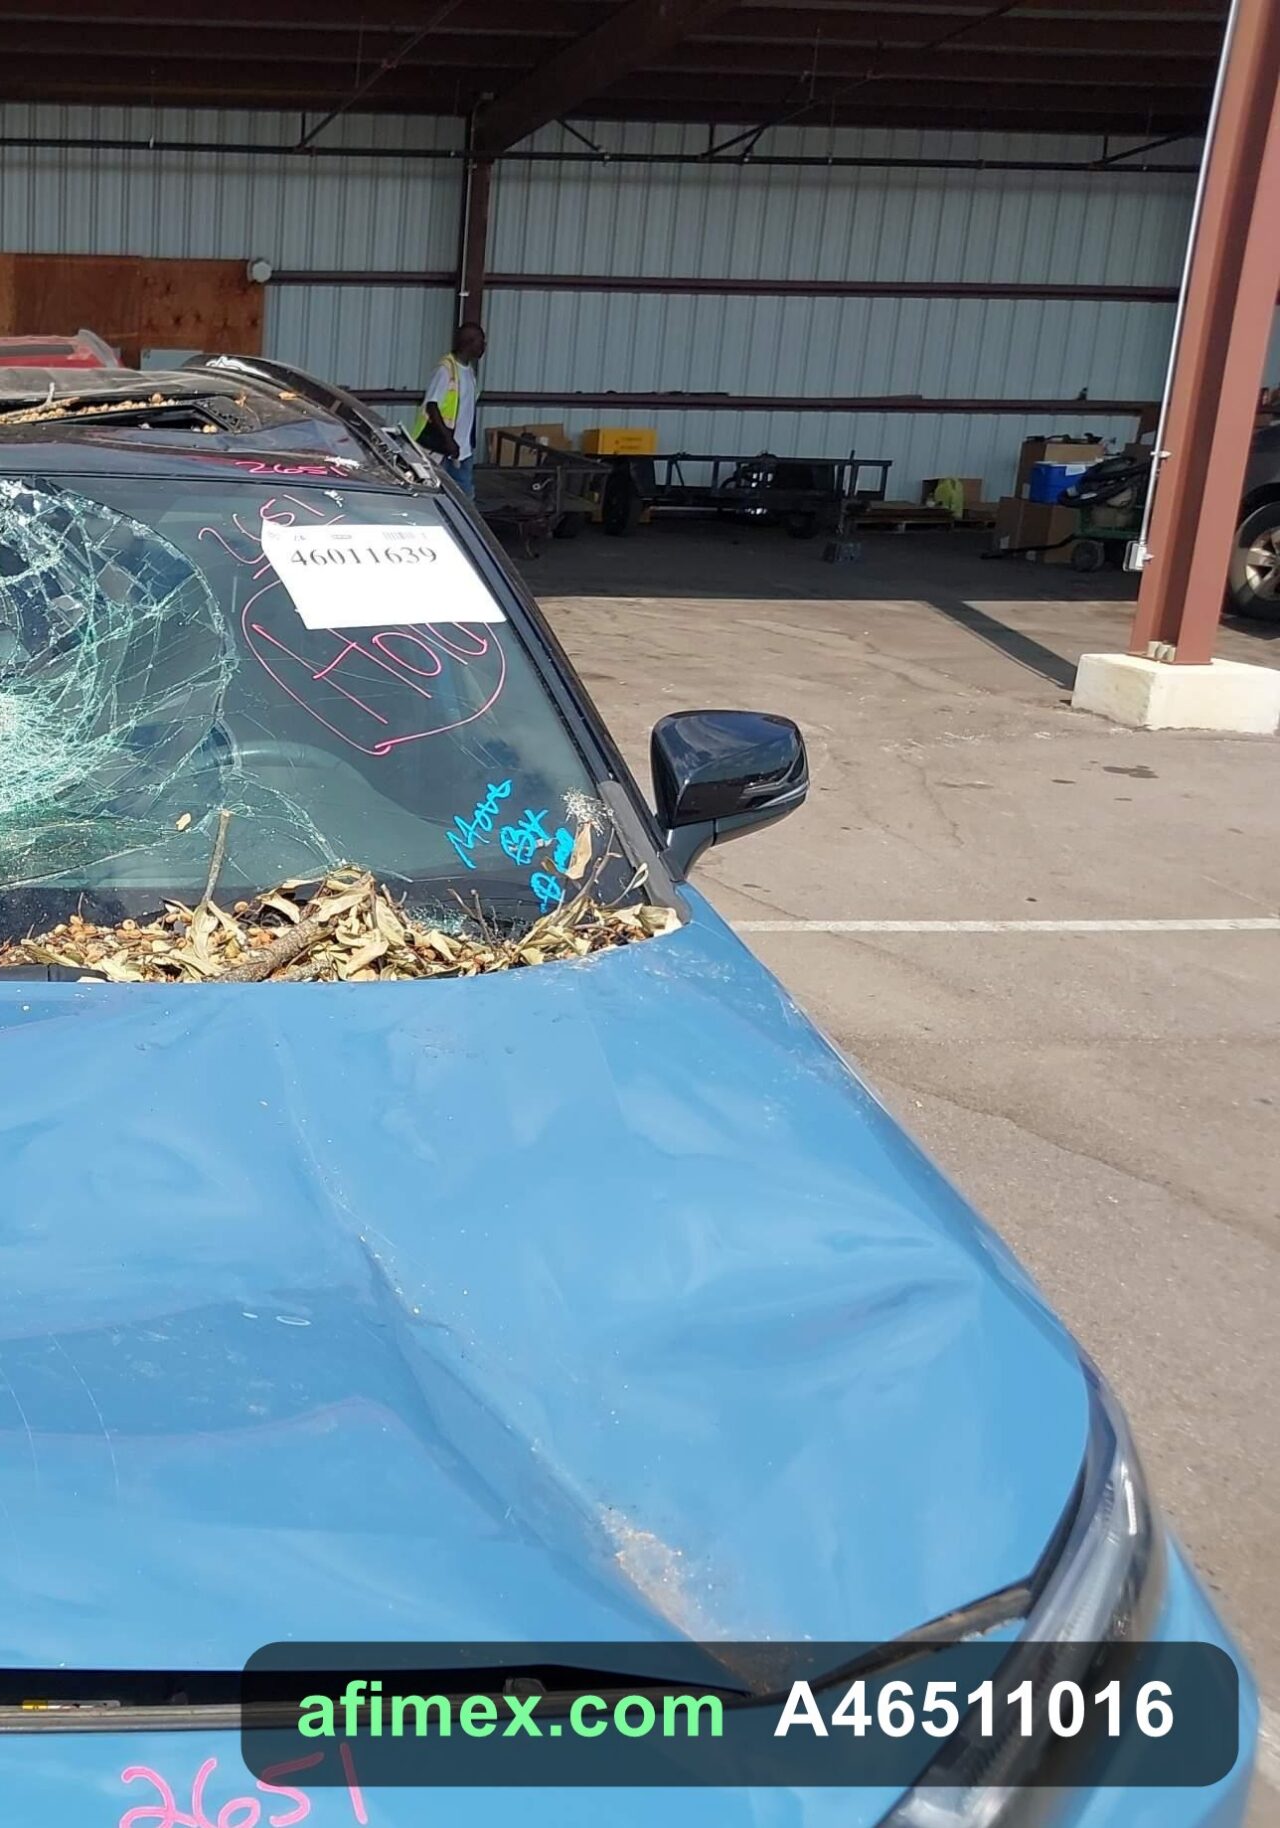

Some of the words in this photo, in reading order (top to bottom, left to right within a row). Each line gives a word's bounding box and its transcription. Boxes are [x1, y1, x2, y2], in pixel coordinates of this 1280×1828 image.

[234, 460, 349, 477] 2651
[290, 546, 438, 567] 46011639
[120, 1742, 368, 1828] 2651
